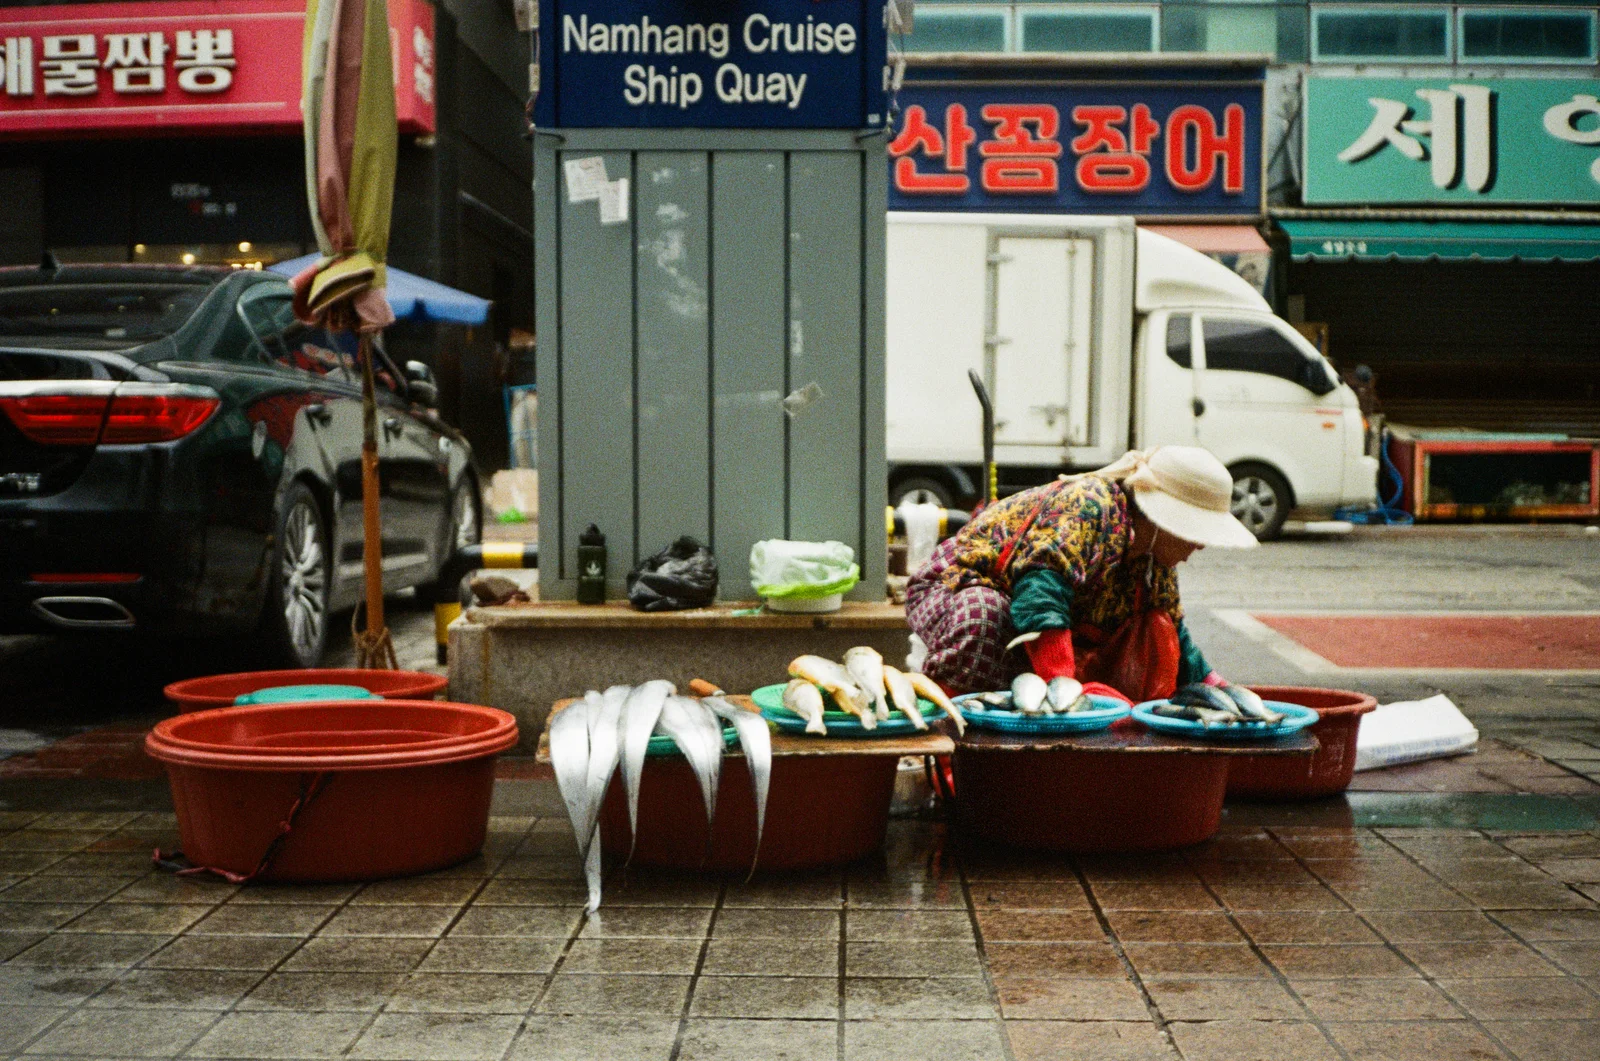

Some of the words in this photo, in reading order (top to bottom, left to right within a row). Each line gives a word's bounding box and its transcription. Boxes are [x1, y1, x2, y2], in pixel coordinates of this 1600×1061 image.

[563, 14, 729, 58] Namhang
[743, 13, 857, 54] Cruise
[624, 64, 703, 109] Ship
[715, 64, 808, 109] Quay
[888, 103, 1246, 193] 산꼼장어
